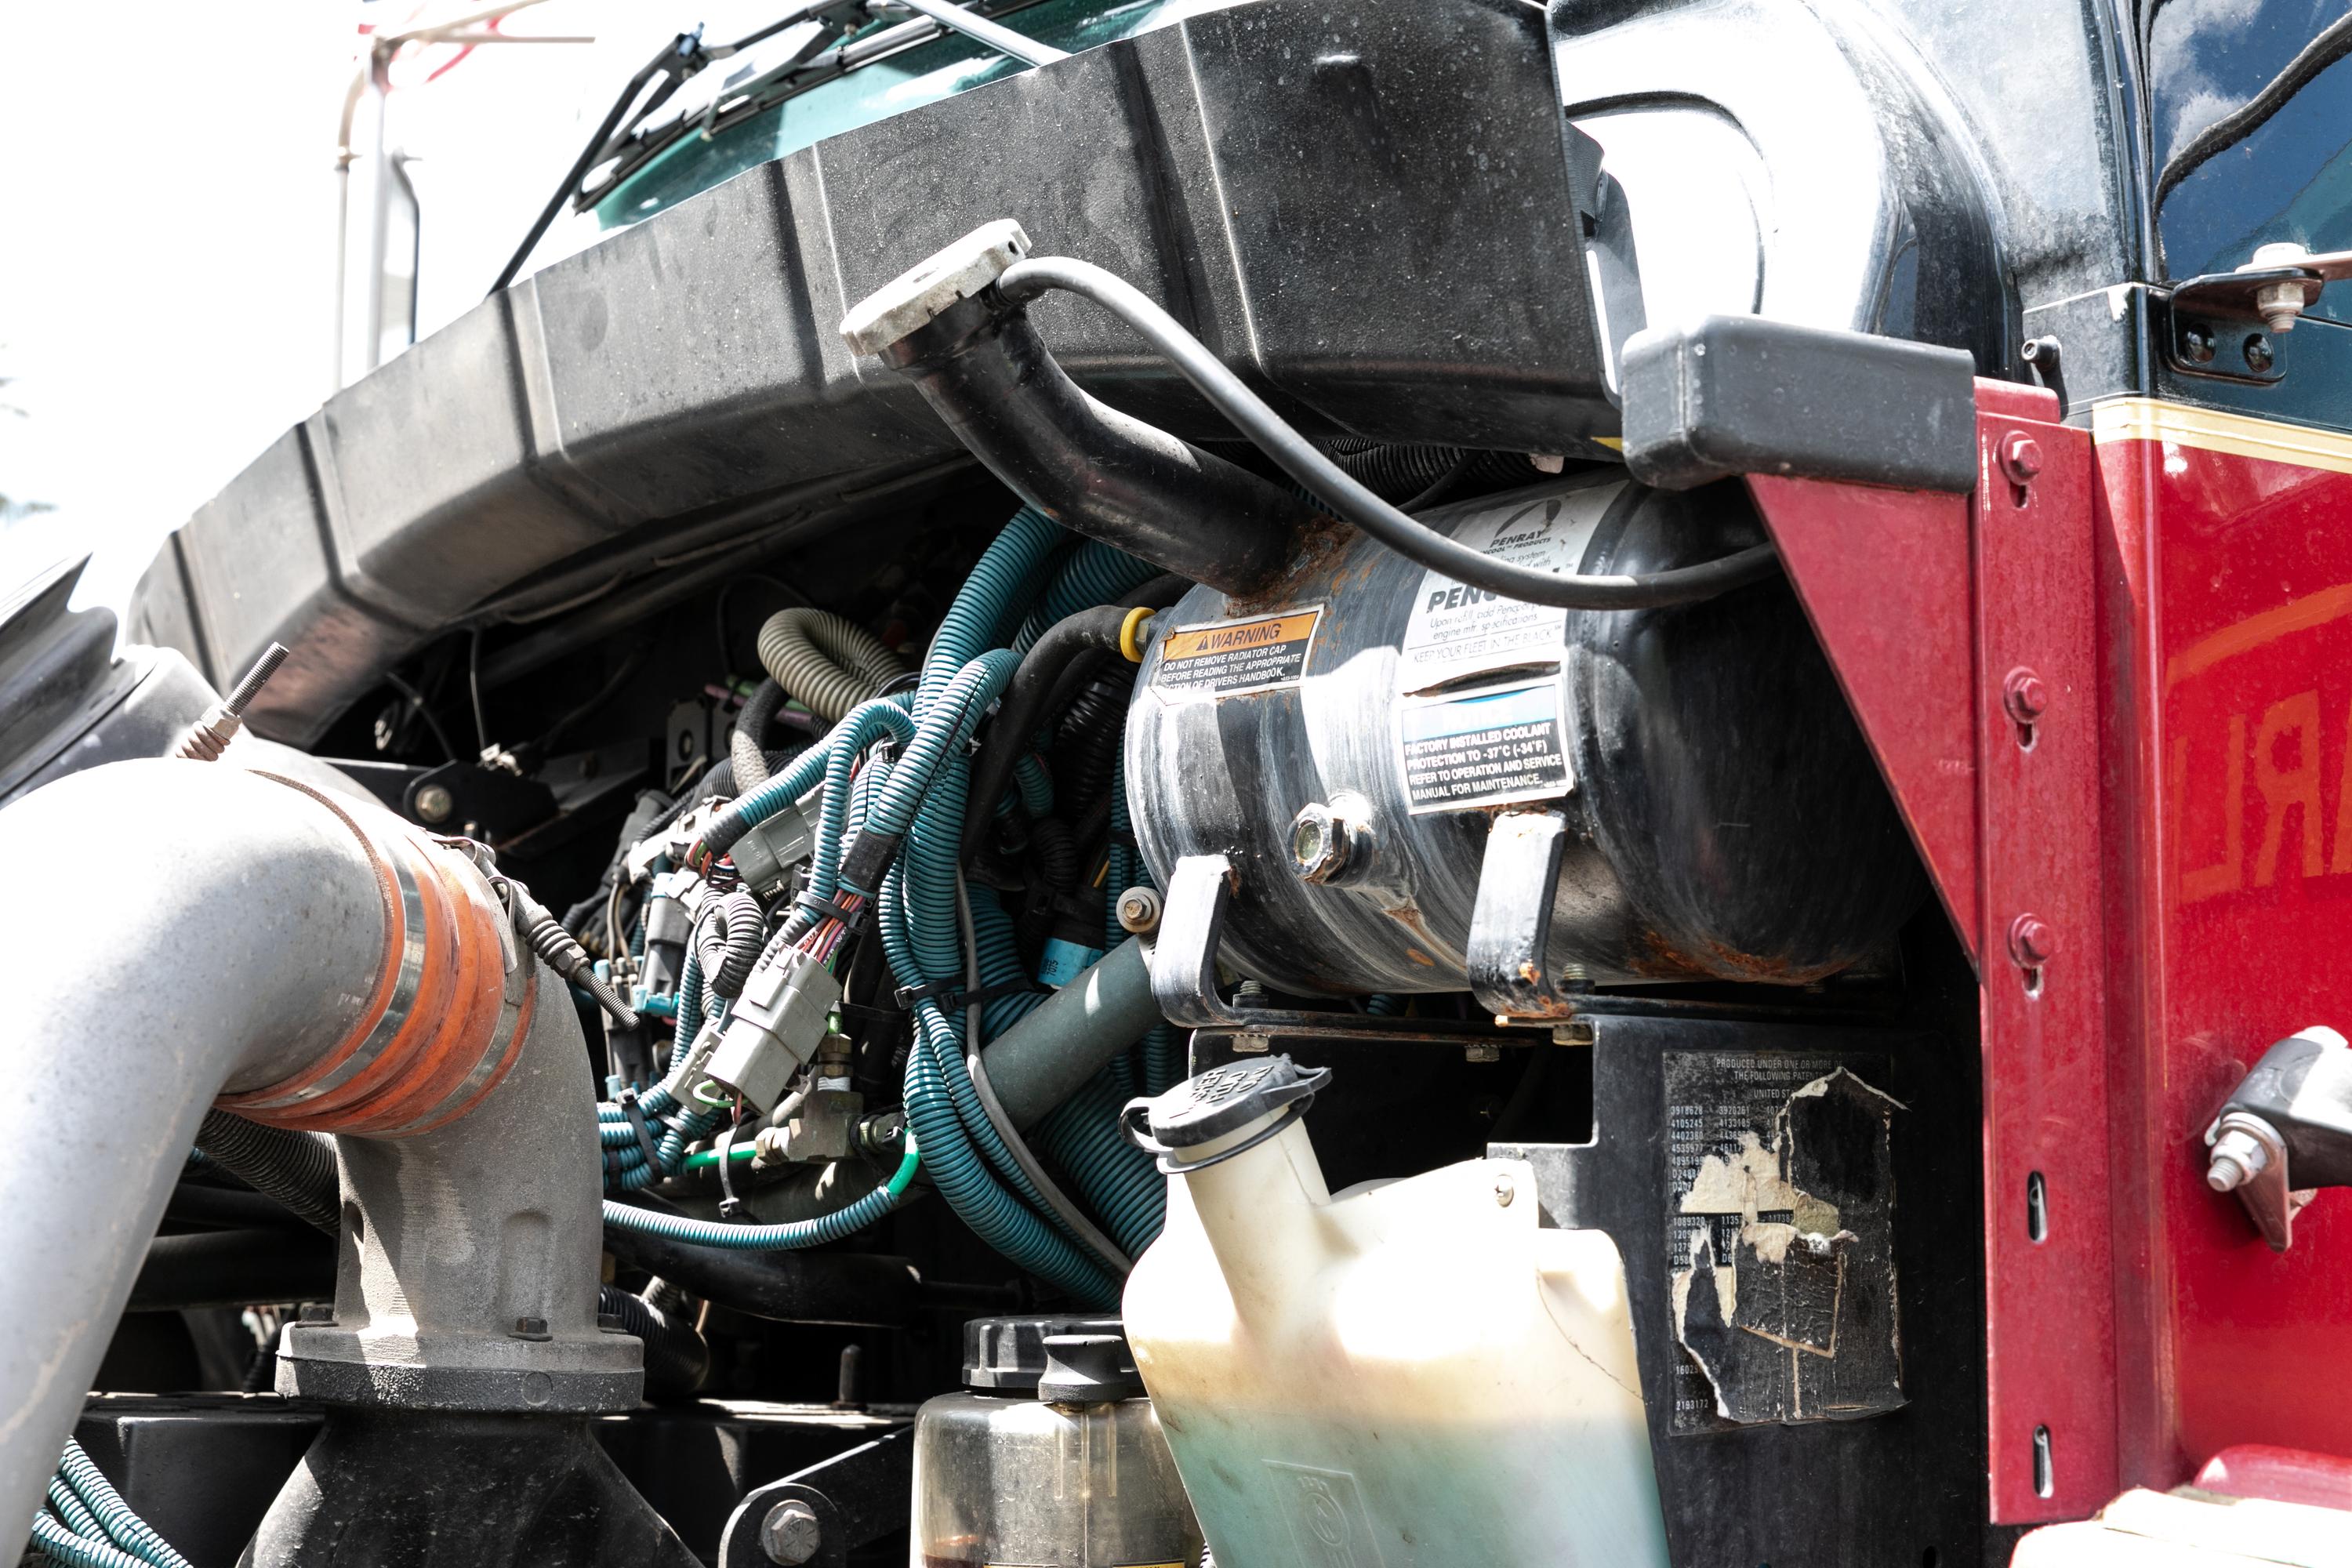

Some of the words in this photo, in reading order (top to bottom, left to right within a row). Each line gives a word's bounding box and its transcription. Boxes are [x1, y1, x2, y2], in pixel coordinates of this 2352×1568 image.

[1490, 530, 1544, 547] PENRAY
[1513, 537, 1551, 550] PRODUCTS
[1517, 550, 1546, 562] system
[1430, 616, 1453, 630] Upon
[1477, 605, 1494, 619] add
[1210, 622, 1282, 649] WARNING
[1433, 628, 1461, 641] engine
[1414, 650, 1435, 663] KEEP
[1437, 645, 1461, 659] YOUR
[1465, 640, 1487, 654] FLEET
[1490, 637, 1501, 649] IN
[1504, 634, 1519, 647] THE
[1163, 662, 1176, 672] DO
[1177, 659, 1194, 670] NOT
[1194, 654, 1228, 667] REMOVE
[1228, 648, 1269, 662] RADIATOR
[1269, 644, 1287, 655] CAP
[1161, 670, 1192, 683] BEFORE
[1192, 665, 1228, 679] READING
[1229, 662, 1245, 673] THE
[1245, 653, 1301, 670] APPROPRIATE
[1192, 680, 1204, 690] OF
[1203, 675, 1238, 688] DRIVERS
[1239, 666, 1286, 684] HANDBOOK.
[1404, 739, 1448, 756] FACTORY
[1449, 730, 1502, 750] INSTALLED
[1503, 722, 1551, 741] COOLANT
[1406, 752, 1466, 771] PROTECTION
[1466, 749, 1481, 762] TO
[1409, 771, 1437, 786] REFER
[1438, 769, 1451, 782] TO
[1451, 762, 1502, 780] OPERATION
[1504, 759, 1523, 773] AND
[1523, 753, 1563, 770] SERVICE
[1412, 785, 1451, 801] MANUAL
[1451, 782, 1471, 796] FOR
[1472, 772, 1544, 793] MAINTENANCE.
[1715, 1058, 1755, 1069] PRODUCED
[1758, 1059, 1782, 1069] UNDER
[1784, 1059, 1798, 1069] ONE
[1801, 1059, 1809, 1069] OR
[1812, 1060, 1832, 1069] MORE
[1734, 1071, 1748, 1080] THE
[1750, 1071, 1791, 1080] FOLLOWING
[1753, 1088, 1780, 1098] UNITED
[1670, 1105, 1703, 1115] 3918628
[1719, 1105, 1749, 1115] 3920261
[1671, 1119, 1703, 1128] 4105245
[1719, 1118, 1751, 1127] 4133185
[1671, 1143, 1704, 1153] 4535977
[1673, 1217, 1705, 1226] 1089320
[1675, 1399, 1708, 1411] 2193172
